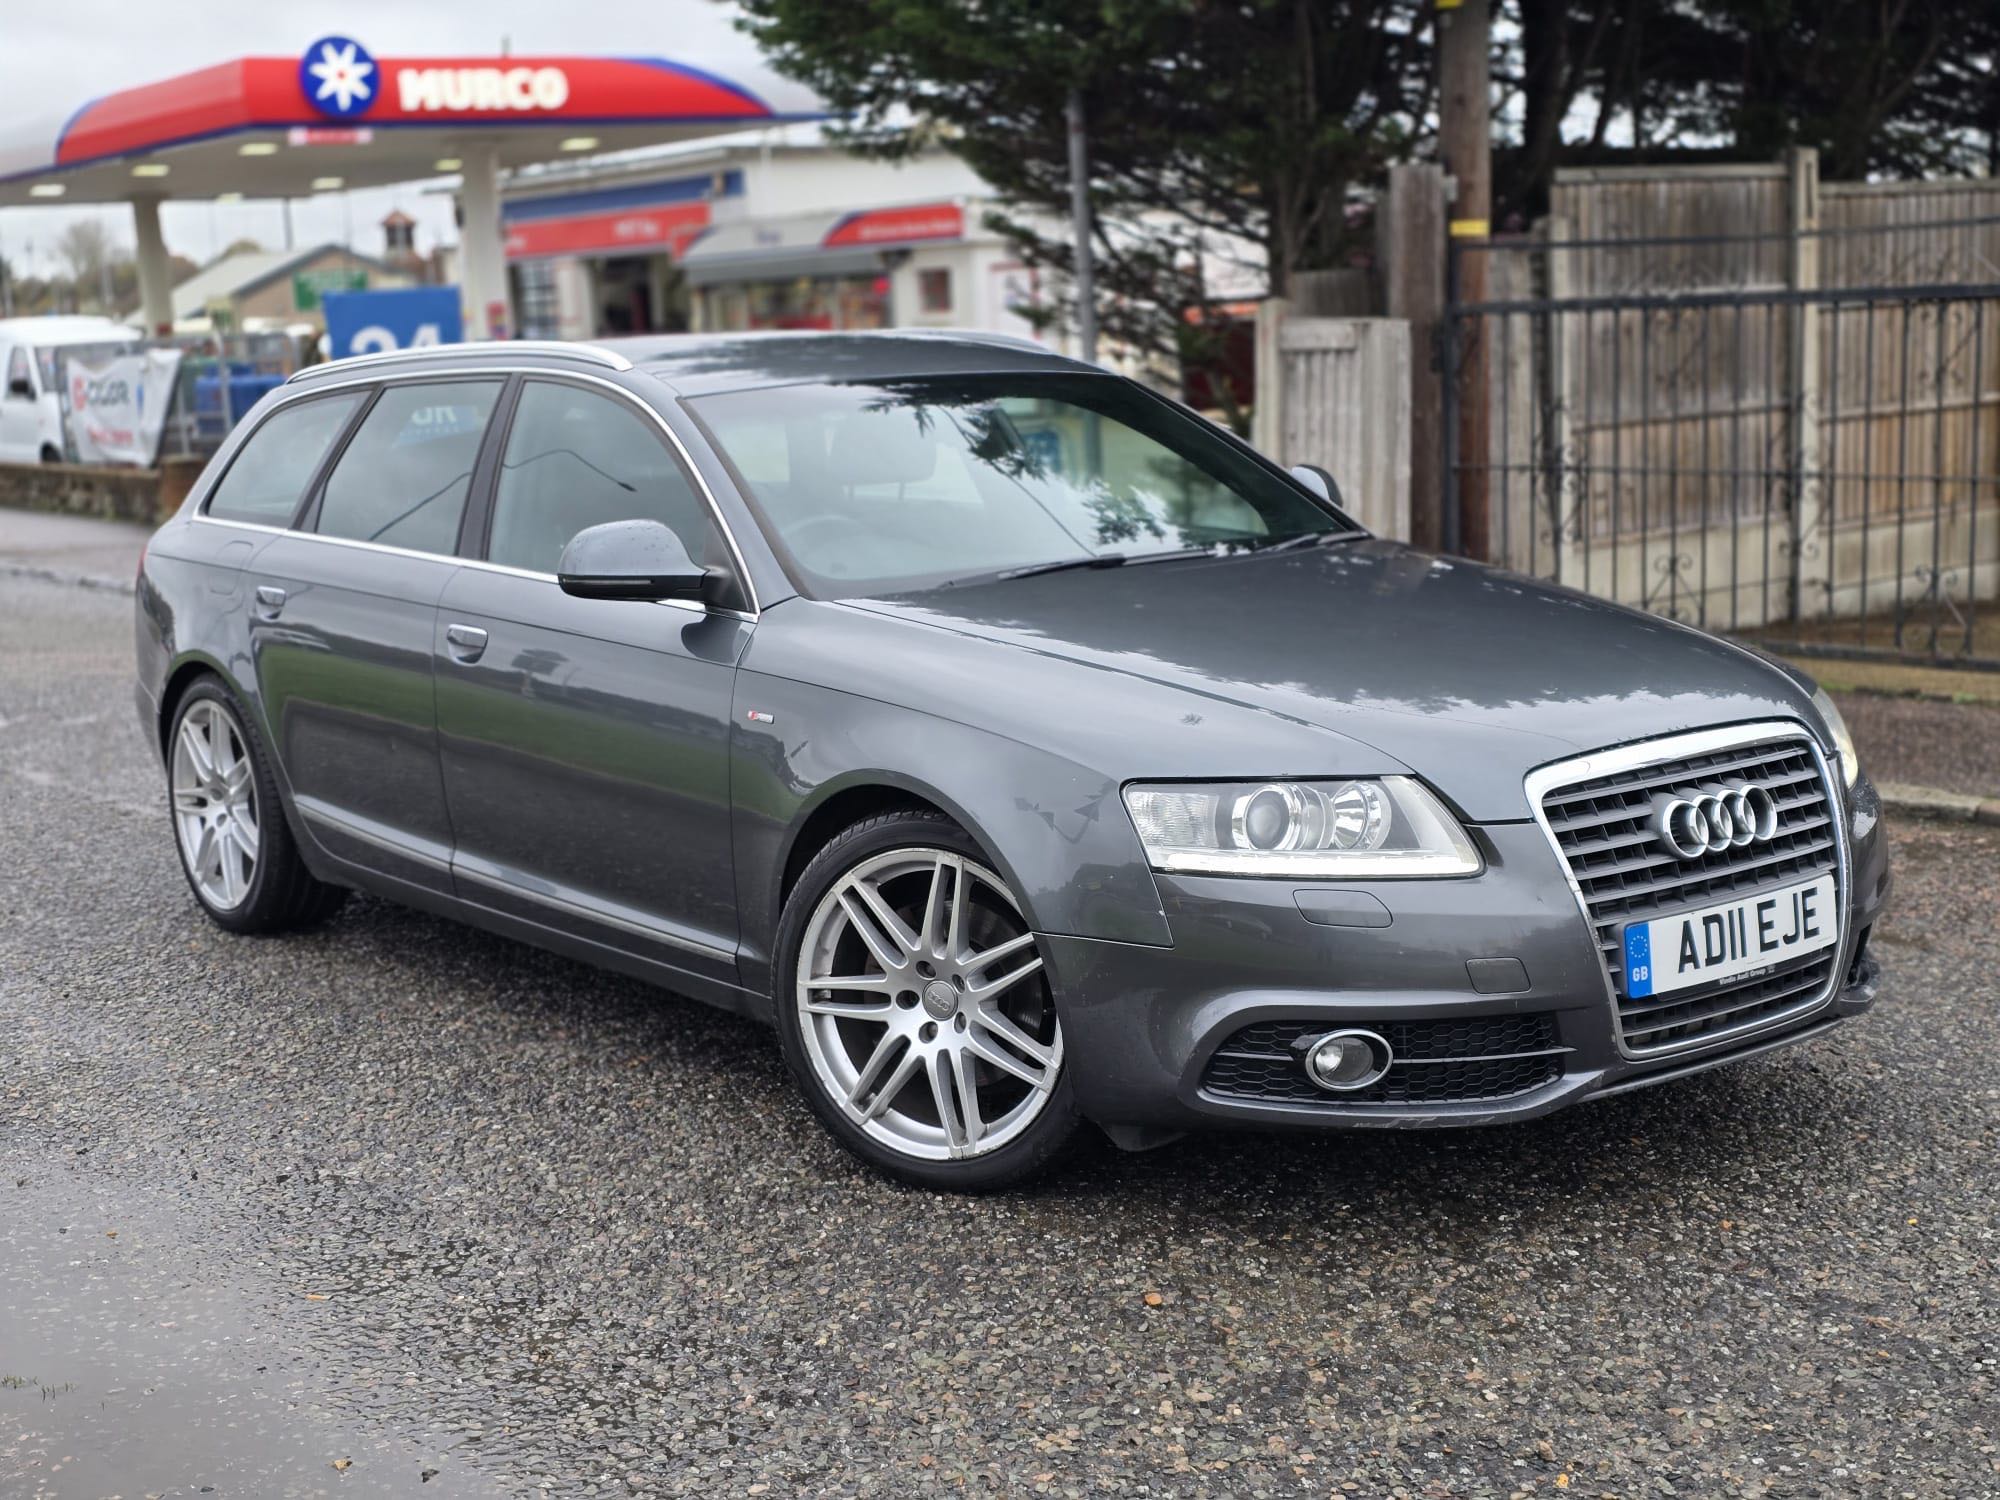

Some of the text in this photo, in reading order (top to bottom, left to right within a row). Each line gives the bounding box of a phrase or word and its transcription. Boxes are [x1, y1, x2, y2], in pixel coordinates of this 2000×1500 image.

[397, 67, 569, 112] MURCO
[1677, 886, 1820, 974] AD11 EJE
[1632, 965, 1648, 982] GB
